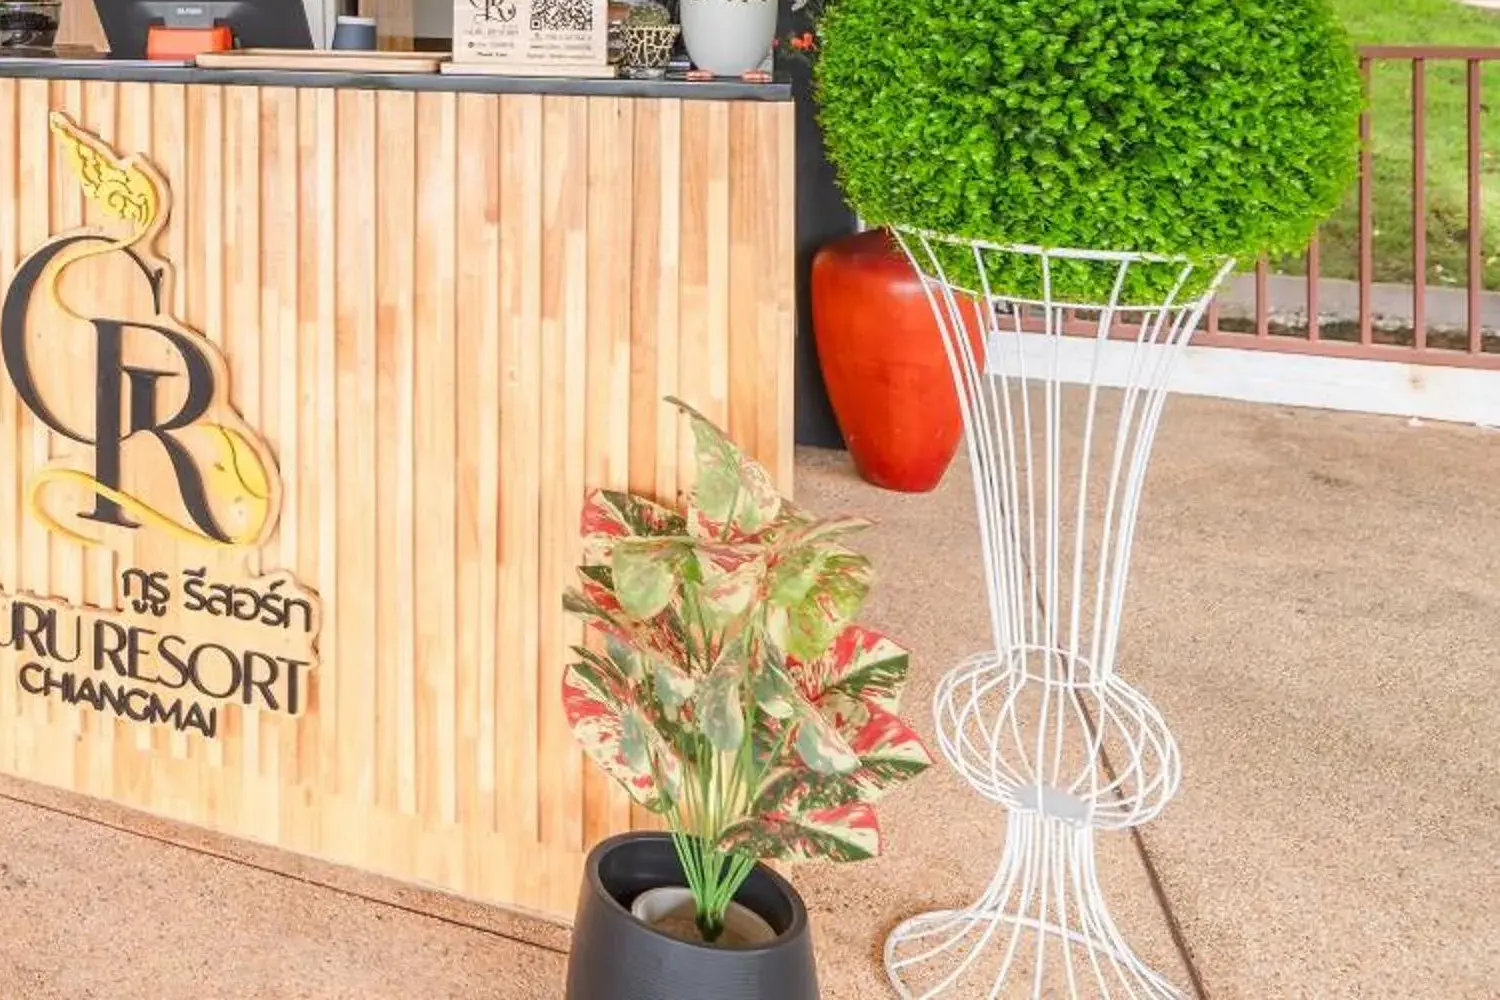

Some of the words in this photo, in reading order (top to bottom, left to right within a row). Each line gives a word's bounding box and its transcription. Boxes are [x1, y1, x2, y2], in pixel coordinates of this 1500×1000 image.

[121, 567, 171, 617] กูรู
[181, 566, 312, 632] รีสอร์ท
[19, 661, 217, 738] CHIANGMAI
[93, 619, 310, 714] RESORT
